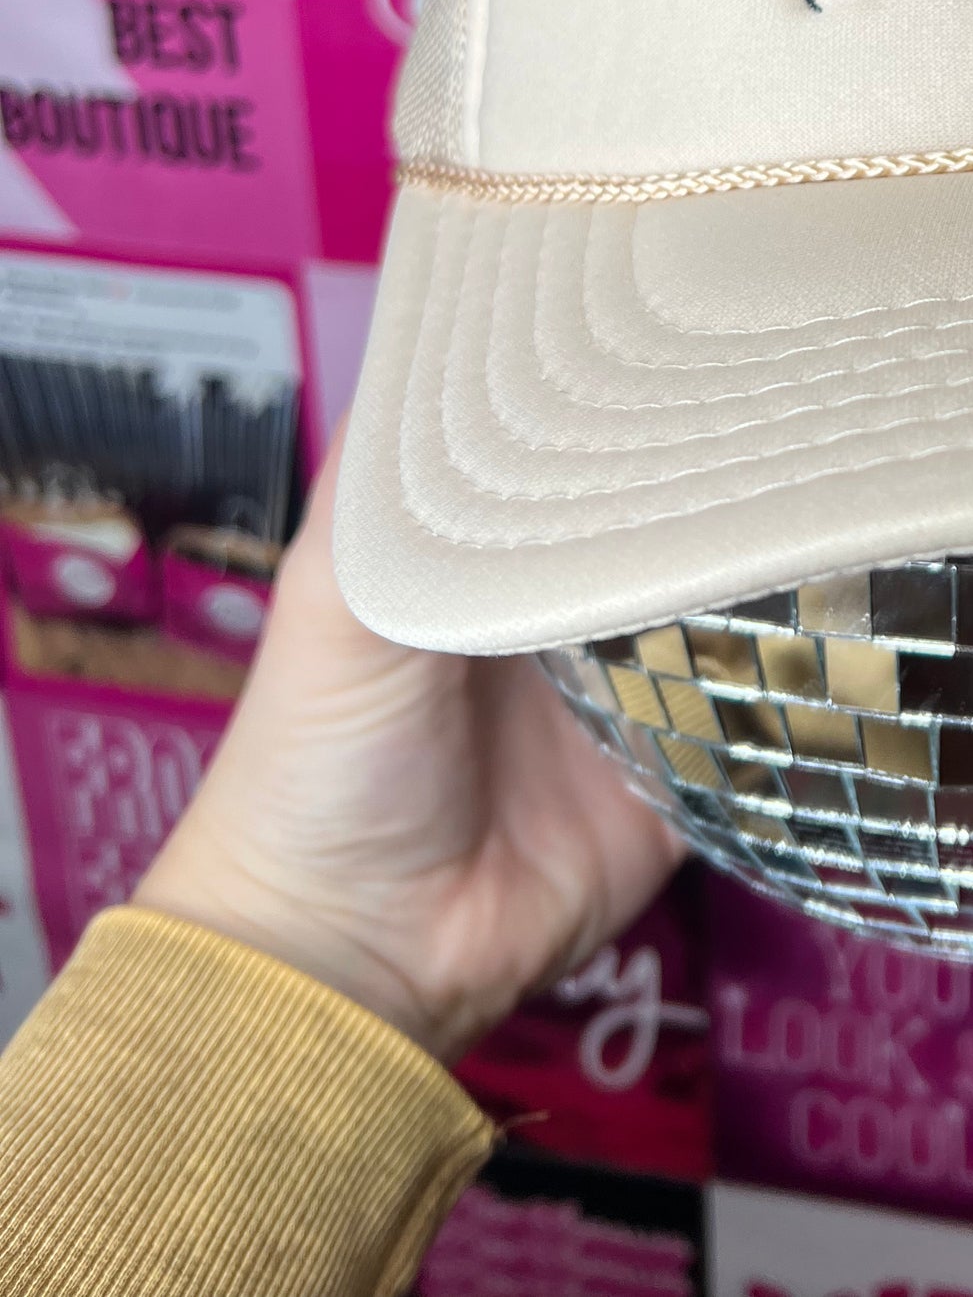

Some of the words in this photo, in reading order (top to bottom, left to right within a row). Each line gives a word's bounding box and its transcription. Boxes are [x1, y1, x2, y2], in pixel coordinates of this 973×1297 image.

[0, 83, 260, 174] BOUTIQUE
[816, 924, 972, 1020] YOU
[722, 982, 934, 1098] LOOK
